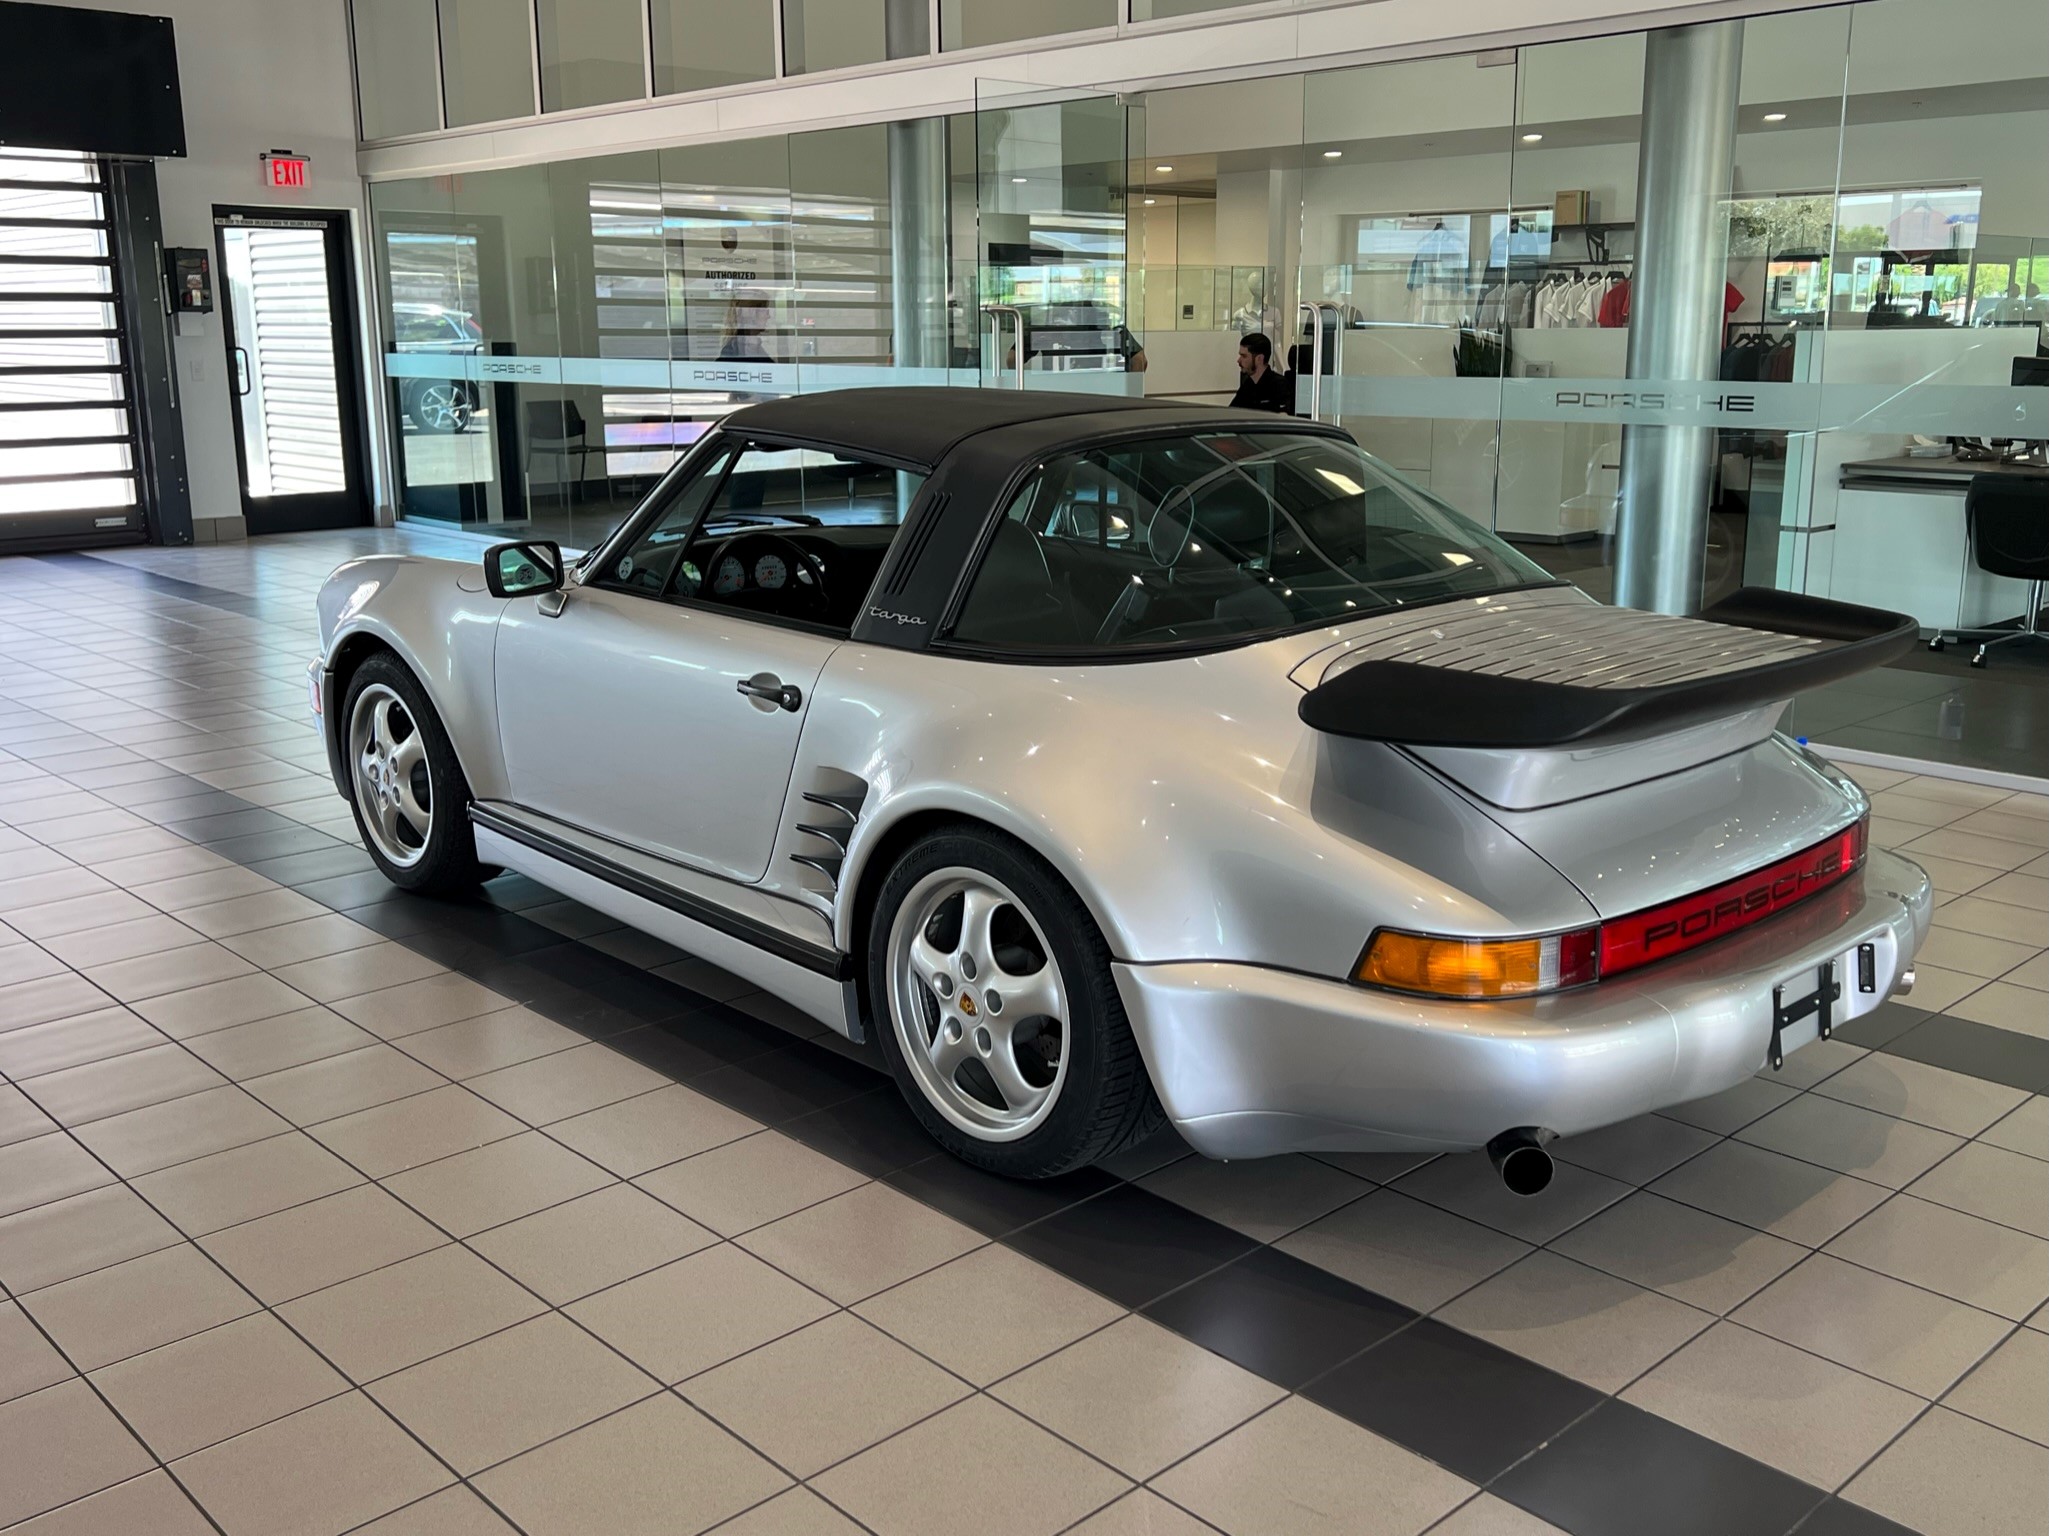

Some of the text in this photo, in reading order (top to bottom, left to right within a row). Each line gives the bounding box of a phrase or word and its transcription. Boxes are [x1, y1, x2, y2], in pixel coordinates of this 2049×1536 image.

[273, 160, 304, 186] EXIT
[705, 270, 756, 280] AUTHORIZED
[483, 364, 542, 374] PORSCHE
[694, 370, 773, 383] PORSCHE
[1556, 392, 1755, 412] PORSCHE
[870, 606, 927, 625] targa
[1644, 852, 1841, 951] PORSCHE
